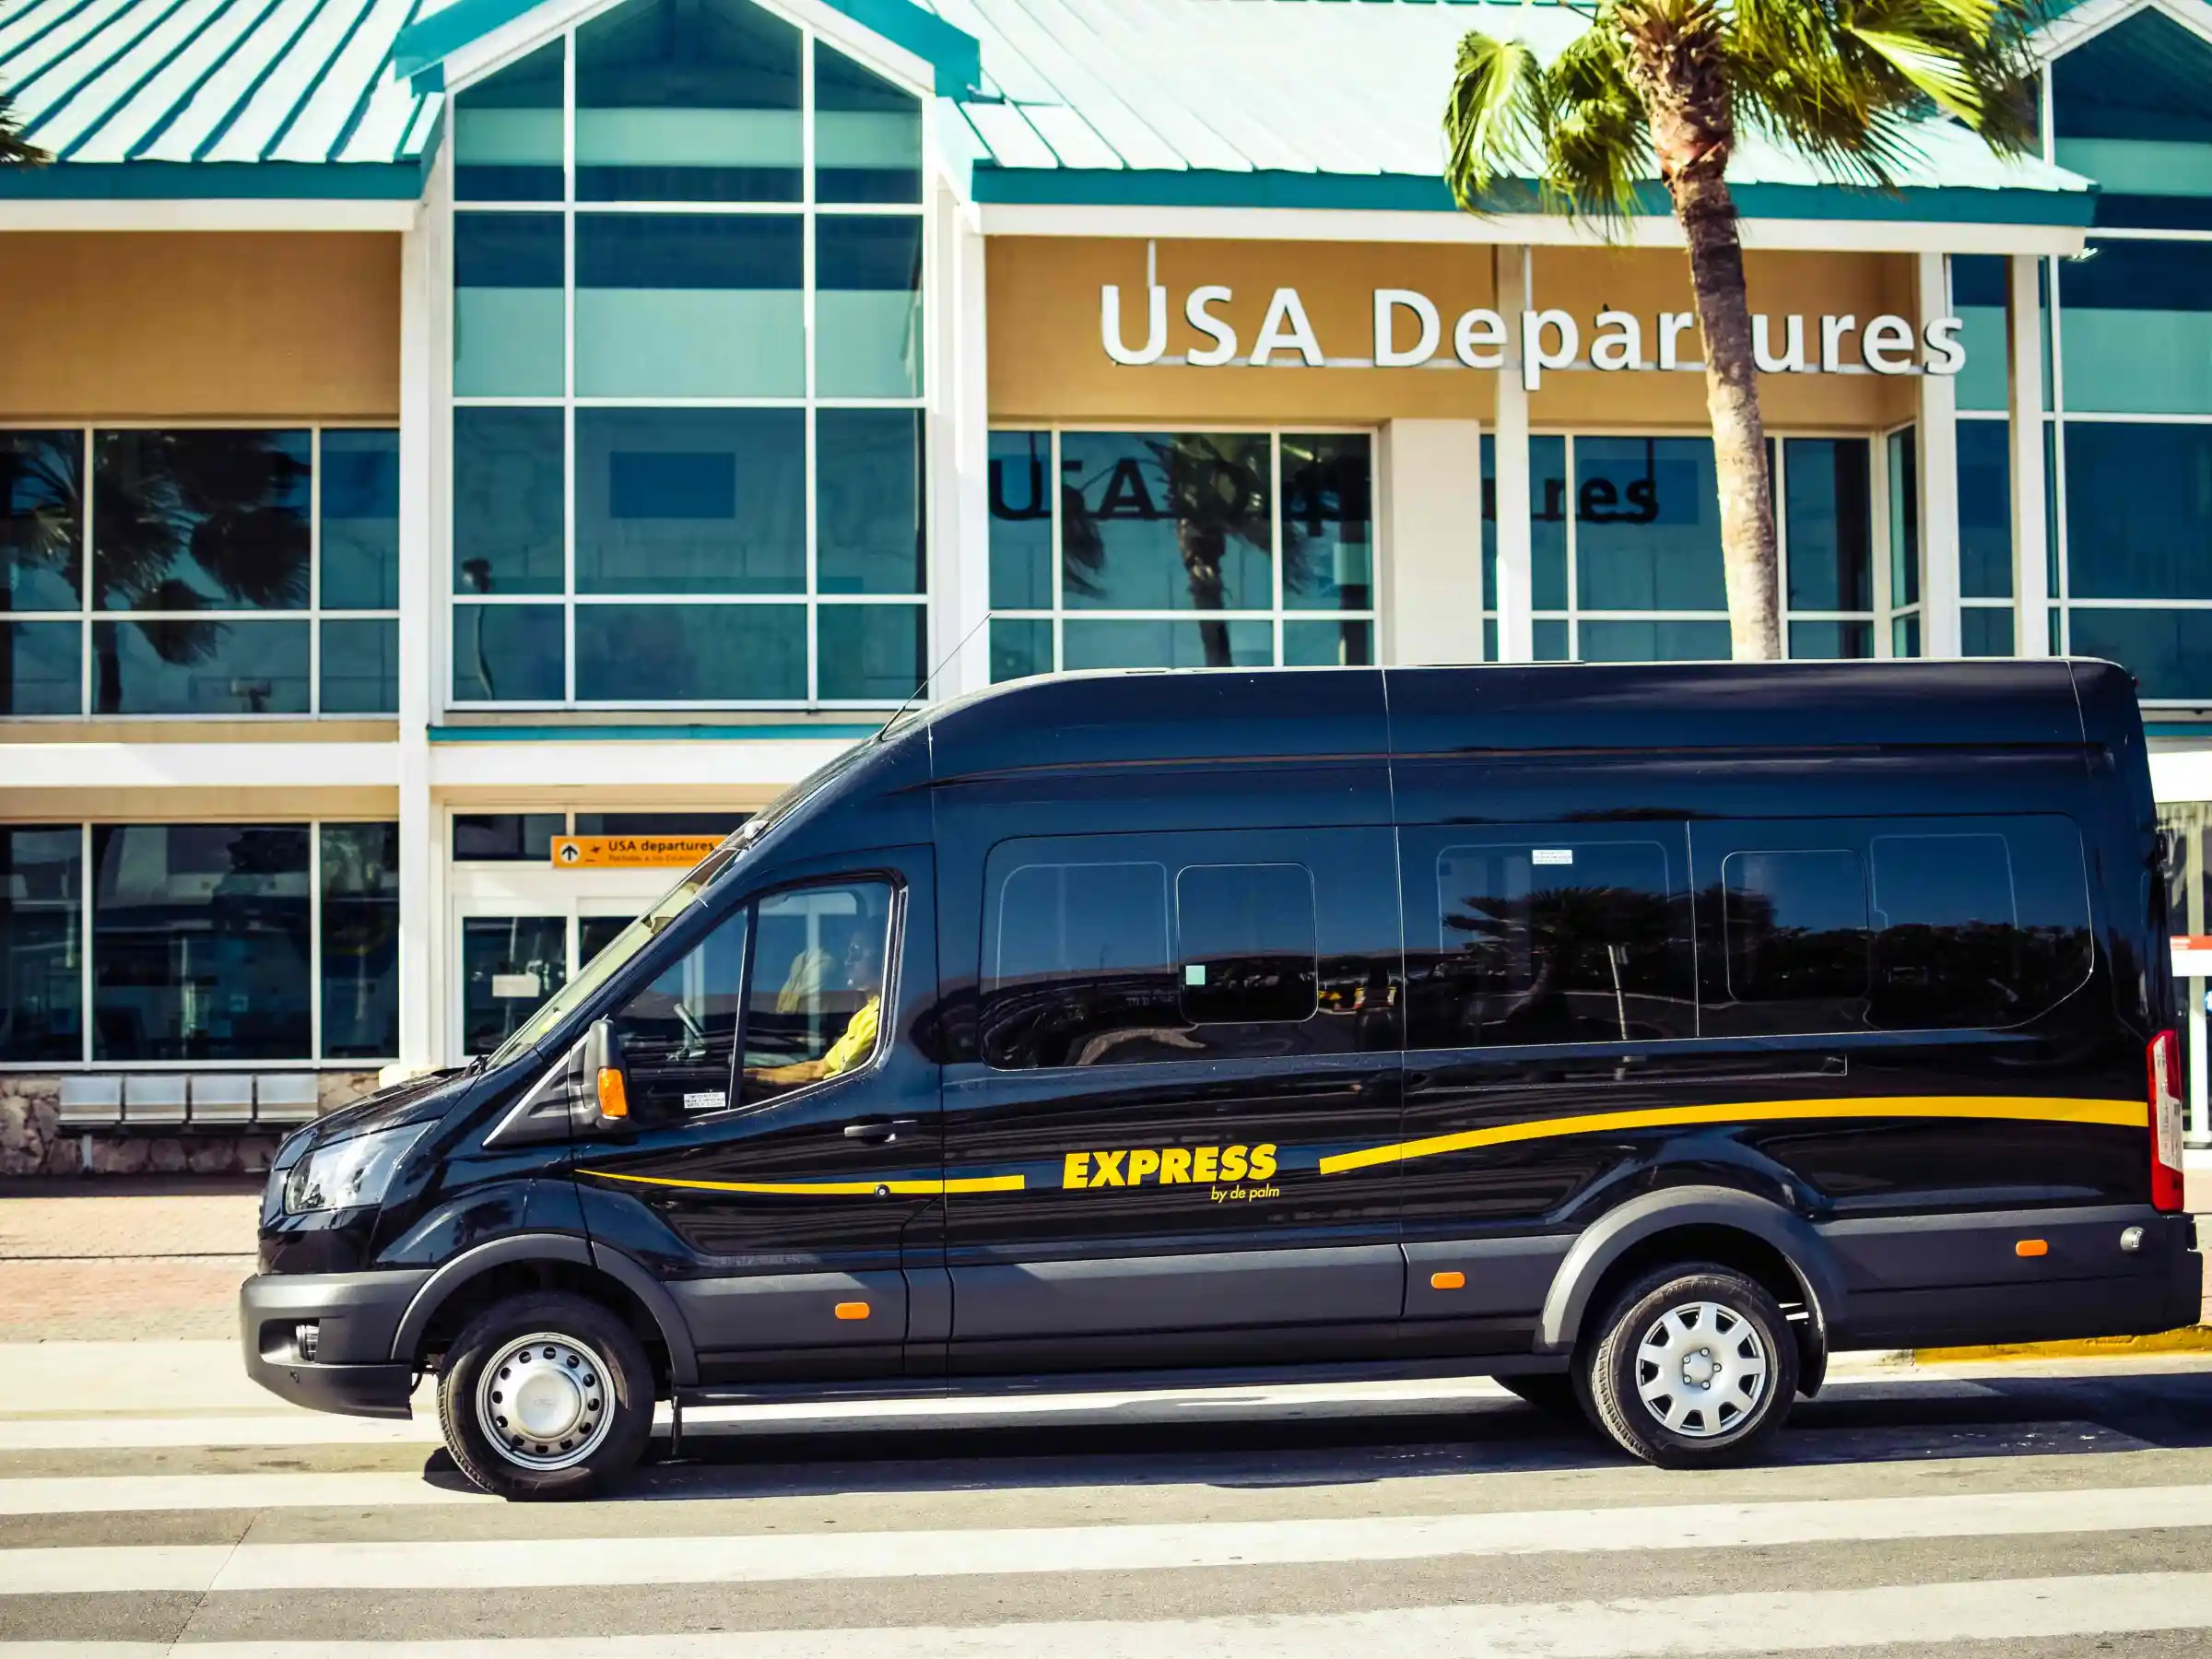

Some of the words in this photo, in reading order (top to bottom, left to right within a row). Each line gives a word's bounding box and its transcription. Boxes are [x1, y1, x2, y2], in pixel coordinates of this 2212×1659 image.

[1100, 284, 1324, 369] USA
[1371, 288, 1967, 392] Deparures
[608, 840, 636, 852] USA
[641, 841, 715, 853] departures
[1063, 1143, 1277, 1190] EXPRESS
[1210, 1185, 1228, 1204] by
[1230, 1184, 1246, 1200] de
[1248, 1182, 1280, 1203] palm
